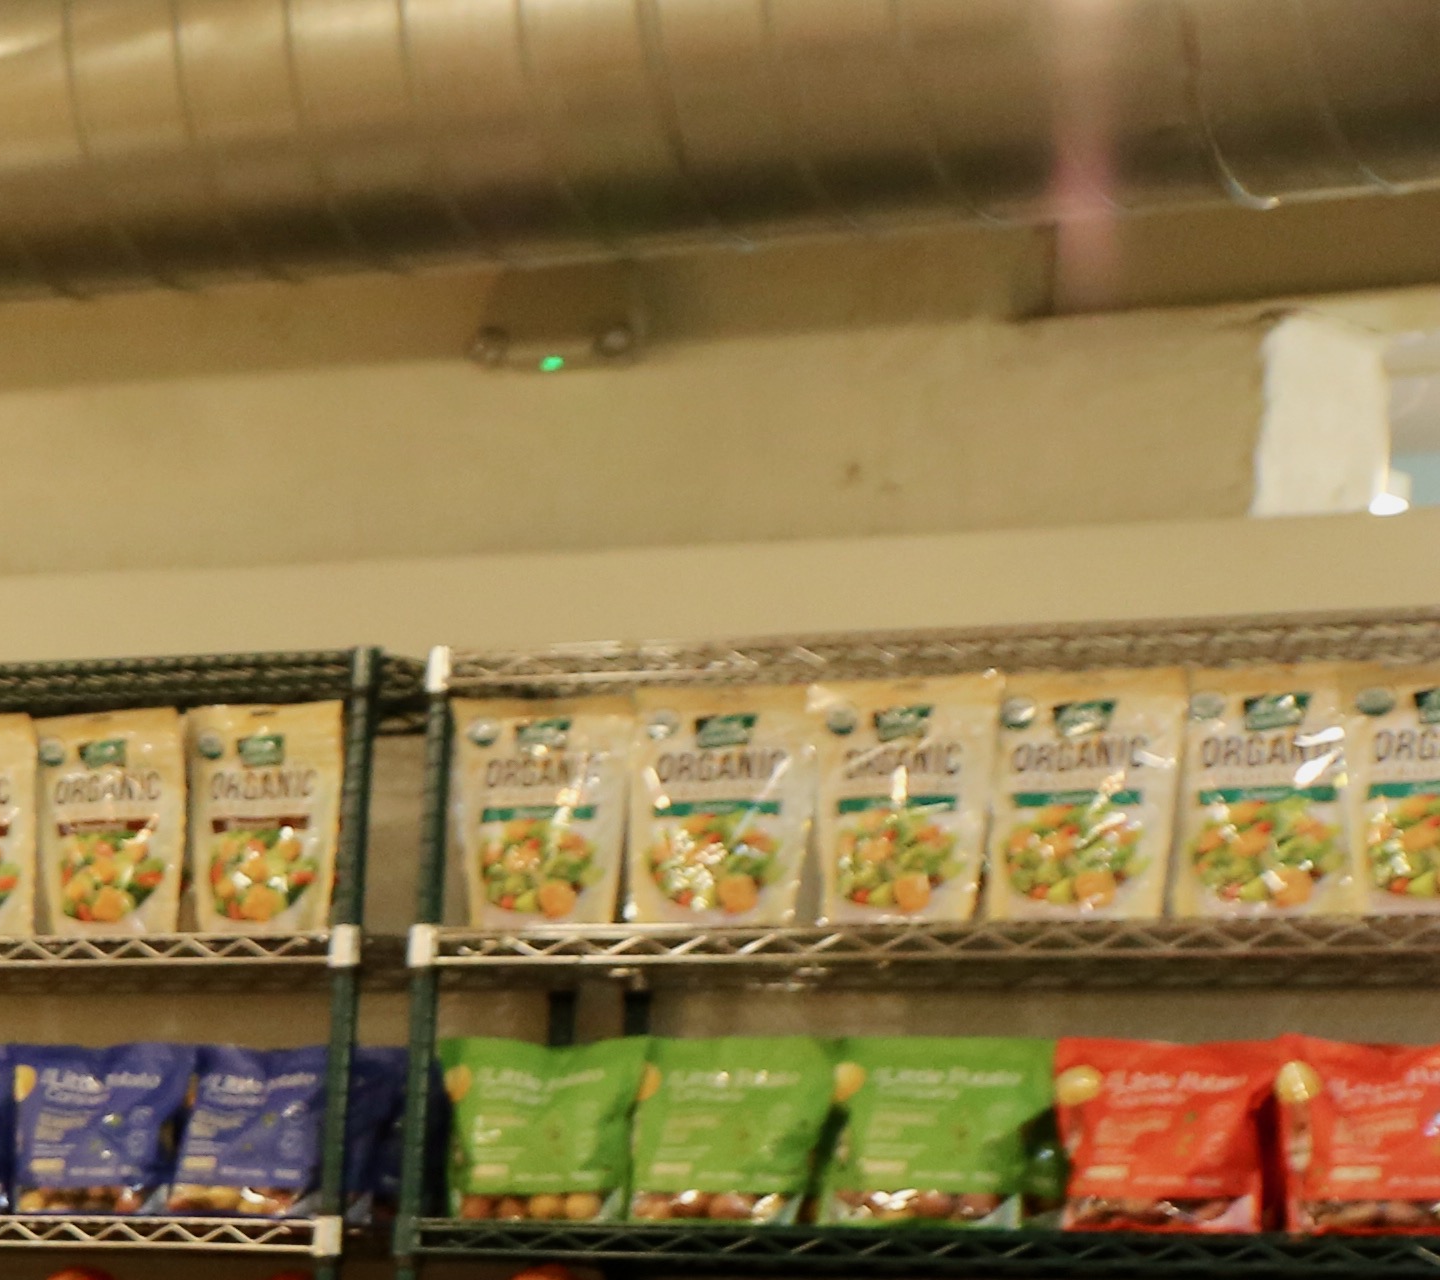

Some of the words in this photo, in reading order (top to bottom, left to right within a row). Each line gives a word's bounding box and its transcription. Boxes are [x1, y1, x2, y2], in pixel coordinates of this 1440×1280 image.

[1012, 733, 1152, 772] ORGANIC
[1201, 728, 1336, 769] ORGAN
[54, 770, 162, 807] ORGANIC
[211, 768, 319, 801] ORGANIC
